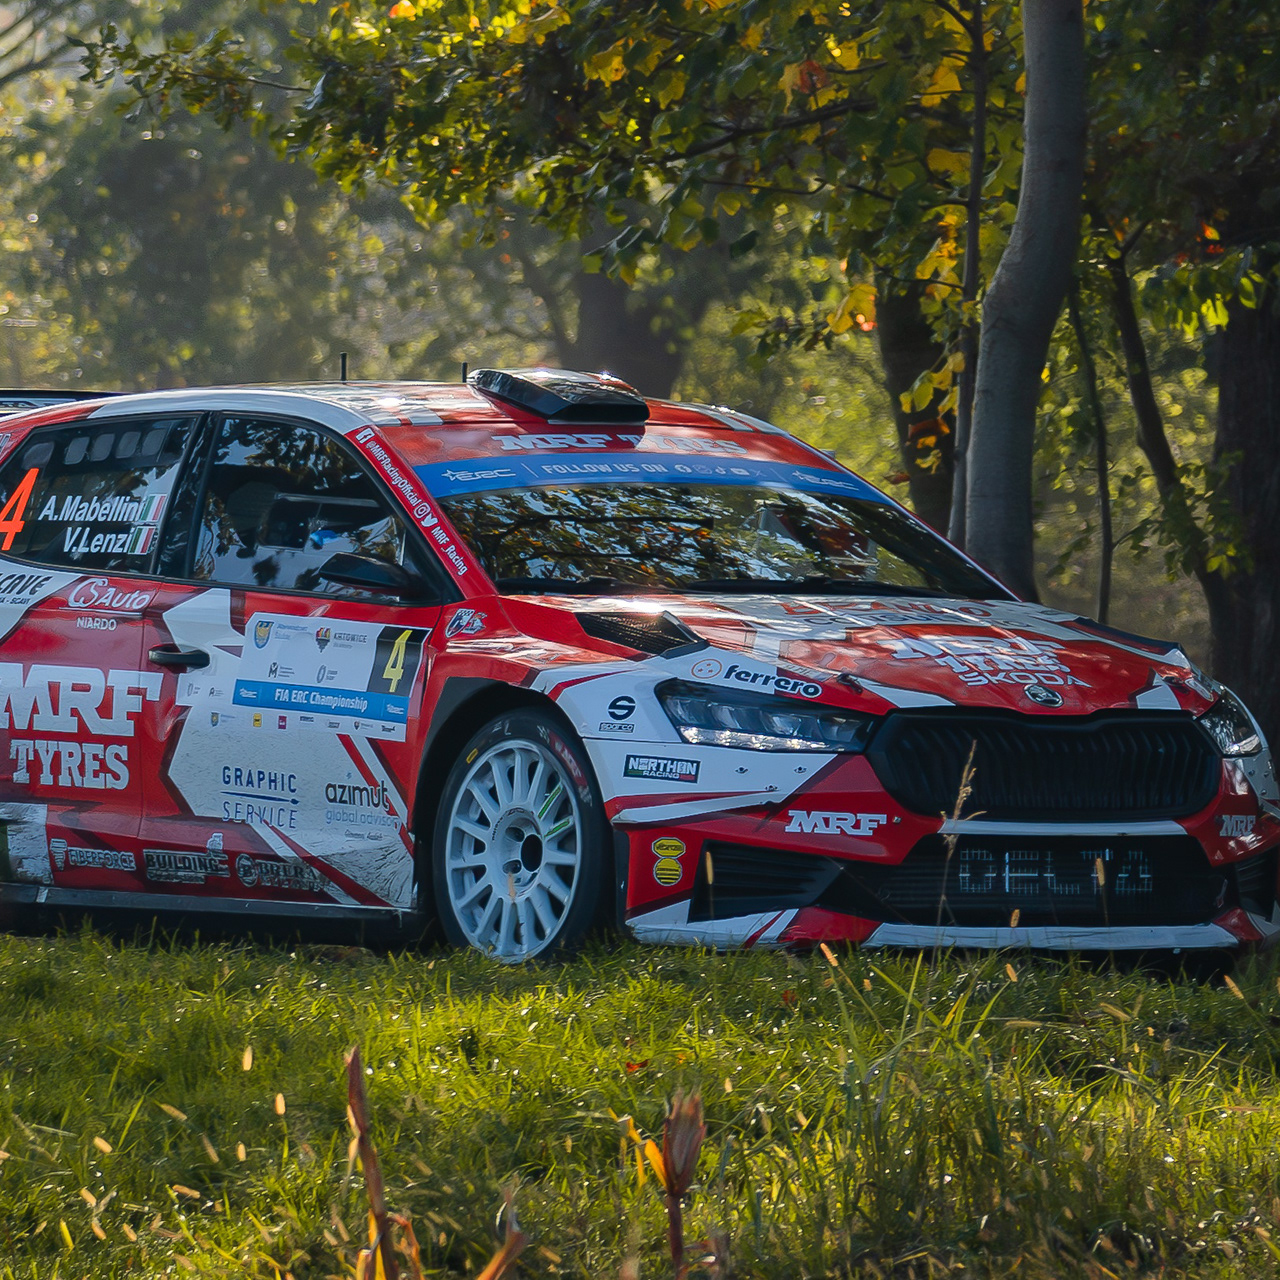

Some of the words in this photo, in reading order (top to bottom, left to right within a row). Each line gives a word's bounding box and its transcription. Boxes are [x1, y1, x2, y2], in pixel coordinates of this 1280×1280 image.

[492, 434, 613, 451] MRF
[616, 433, 748, 455] TYRES
[541, 463, 613, 474] FOLLOW
[614, 463, 640, 473] US
[642, 463, 668, 473] ON
[38, 495, 147, 522] A.Mabellini
[63, 526, 134, 553] V.Lenzi
[77, 617, 117, 631] NIARDO
[382, 630, 413, 693] 4
[723, 664, 822, 699] ferrero
[275, 688, 289, 702] FIA
[291, 689, 309, 704] ERC
[310, 691, 368, 713] Championship
[9, 739, 130, 790] TYRES
[643, 770, 680, 779] RACING
[222, 765, 297, 793] GRAPHIC
[325, 780, 391, 811] azimut
[222, 801, 298, 829] SERVICE
[326, 809, 358, 824] global
[785, 810, 887, 836] MRF
[1220, 815, 1256, 837] MRF
[145, 853, 219, 872] BUILDING
